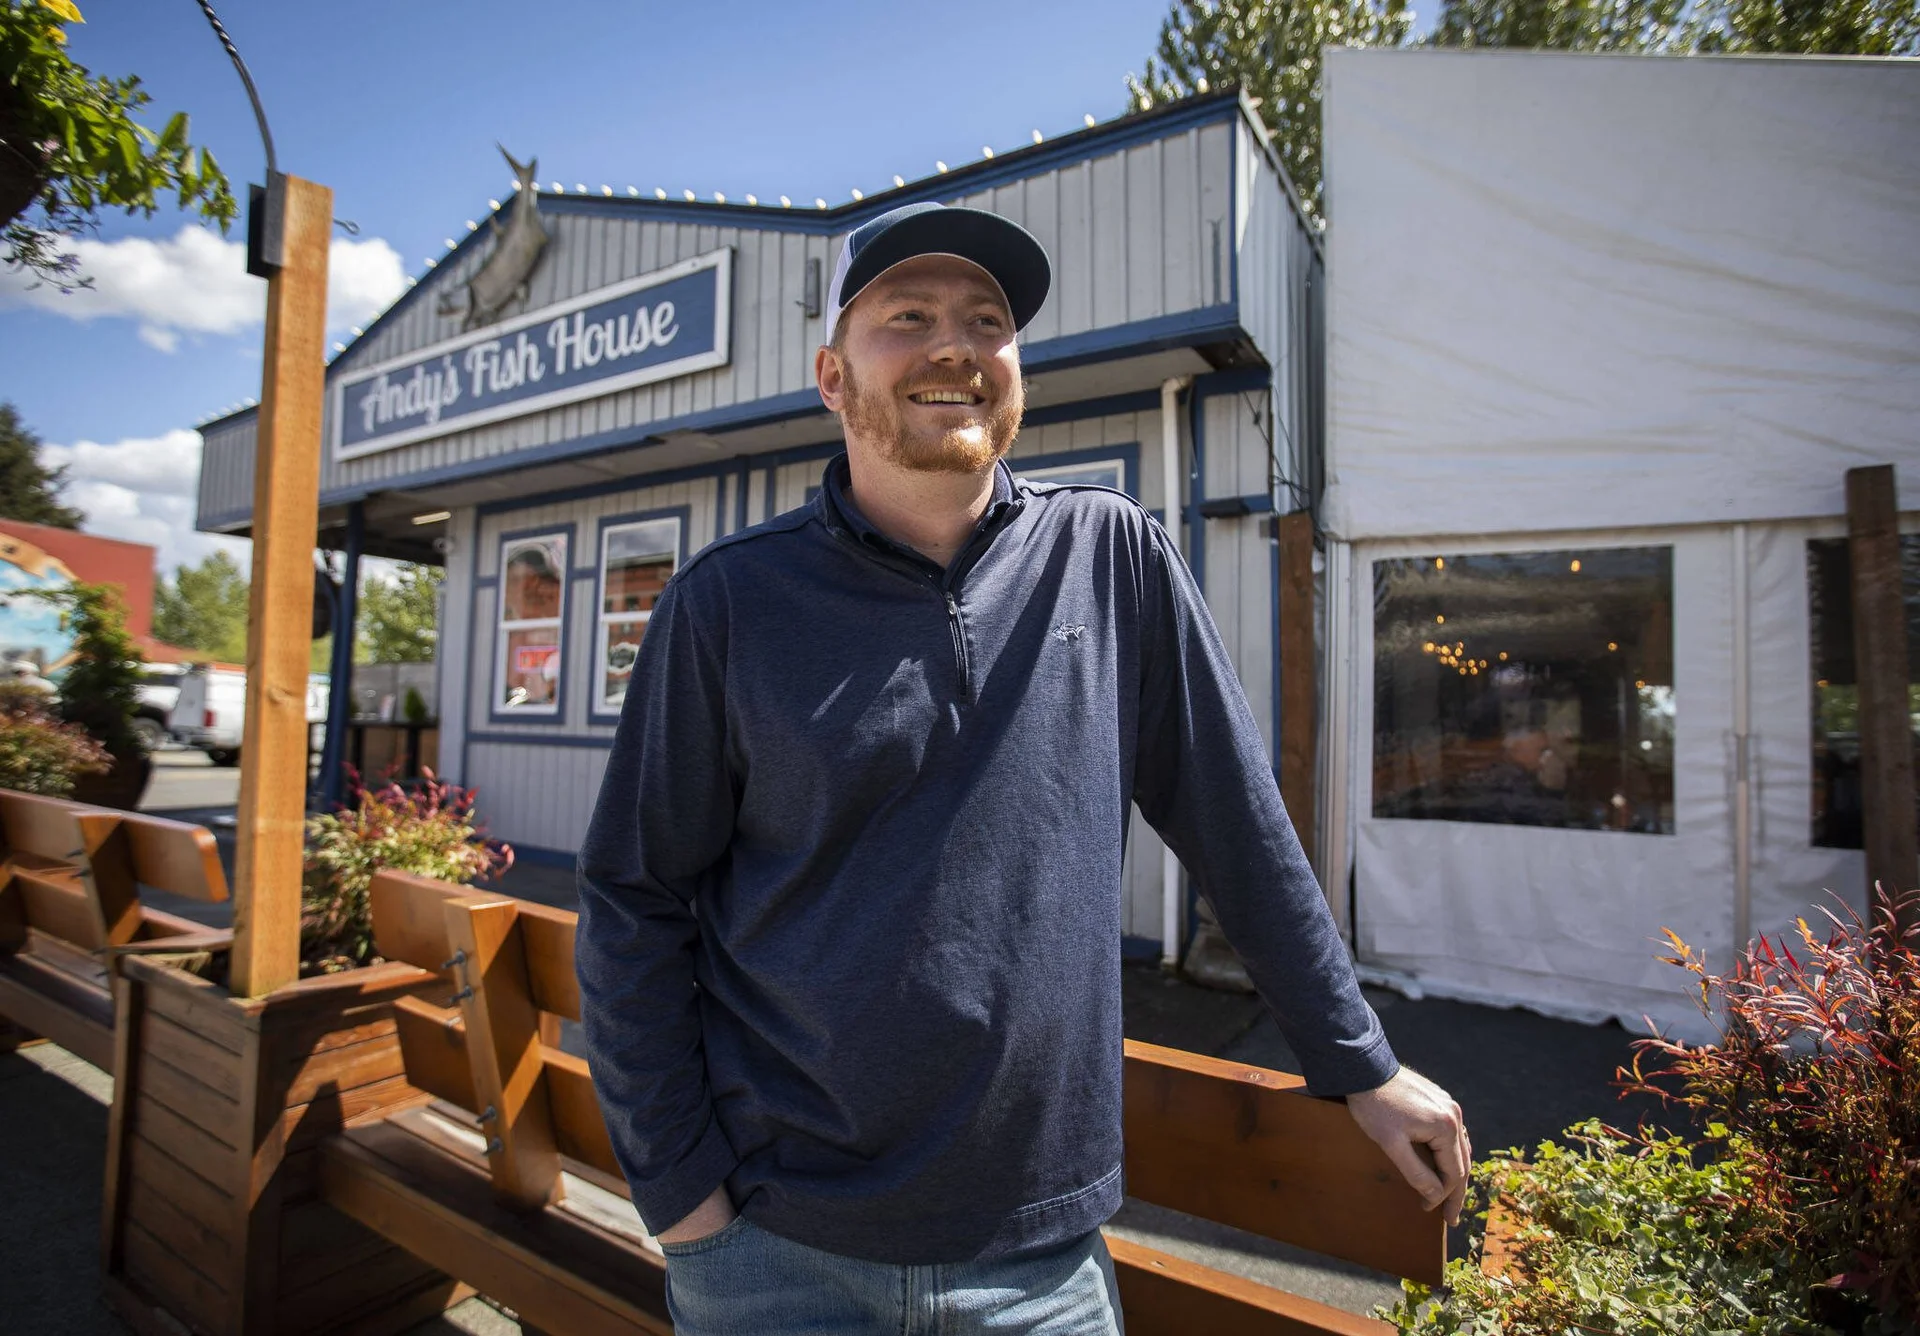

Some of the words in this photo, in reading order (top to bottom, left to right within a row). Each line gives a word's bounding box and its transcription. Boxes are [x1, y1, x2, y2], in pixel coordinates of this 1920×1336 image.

[360, 354, 462, 433] Andy's
[464, 333, 545, 397] Fish
[548, 300, 679, 374] House
